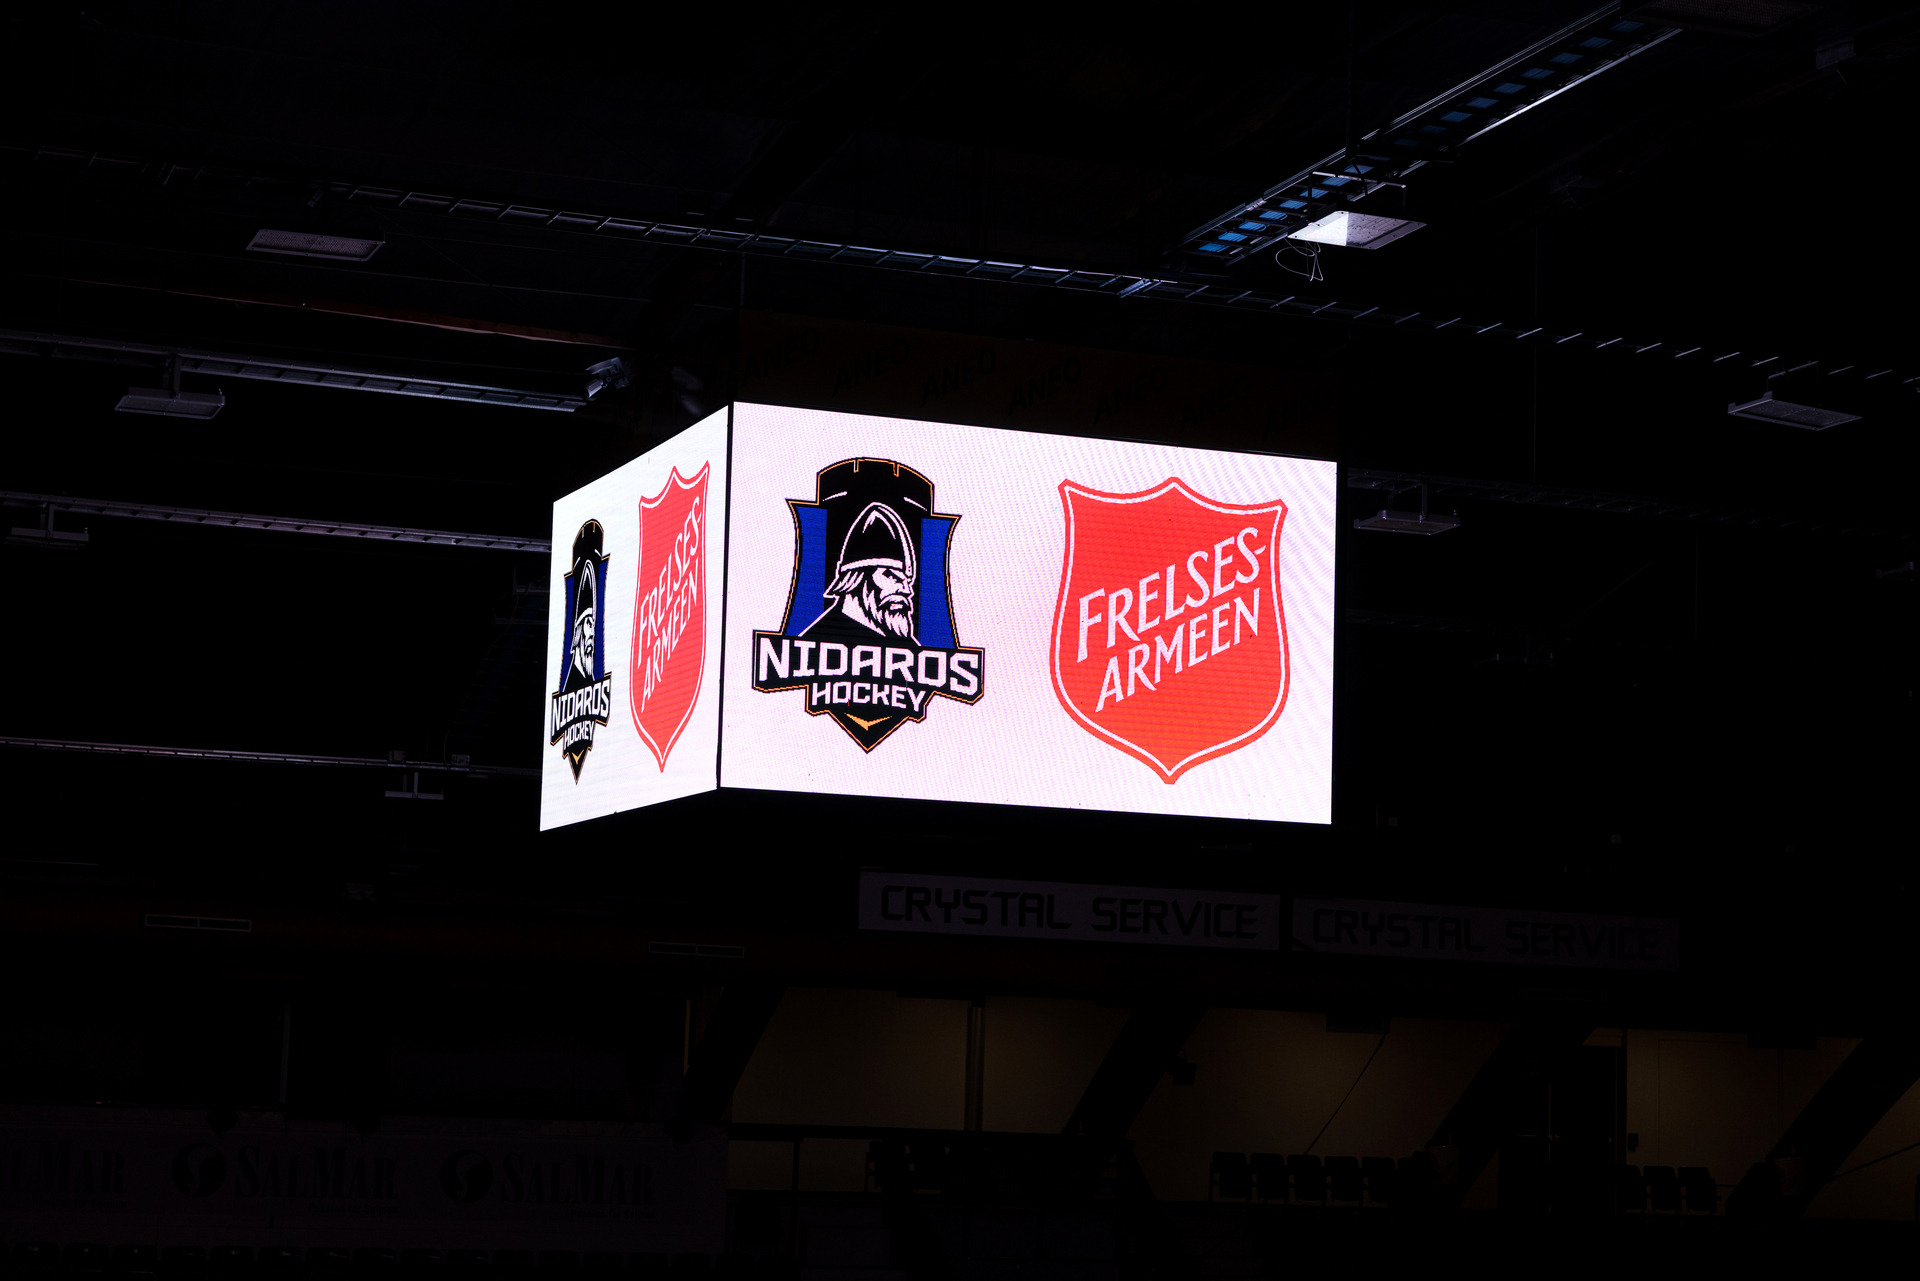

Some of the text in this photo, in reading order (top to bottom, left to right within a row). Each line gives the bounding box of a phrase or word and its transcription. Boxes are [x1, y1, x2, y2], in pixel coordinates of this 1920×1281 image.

[741, 327, 821, 388] ANEO
[832, 337, 909, 397] ANEO
[921, 347, 997, 407] ANEO
[1007, 356, 1082, 416] ANEO
[1093, 365, 1168, 426] ANEO
[1178, 374, 1251, 434] ANEO
[1077, 526, 1266, 664] FRELSES-
[641, 556, 699, 714] ARMEEN
[1094, 587, 1260, 714] ARMEEN
[758, 636, 980, 696] NIDAROS
[551, 679, 611, 737] NIDAROS
[811, 681, 926, 712] HOCKEY
[564, 720, 595, 751] HOCKEY
[881, 884, 1259, 940] CRYSTAL SERVICE
[1312, 908, 1661, 962] CRYSTAL SERVICE
